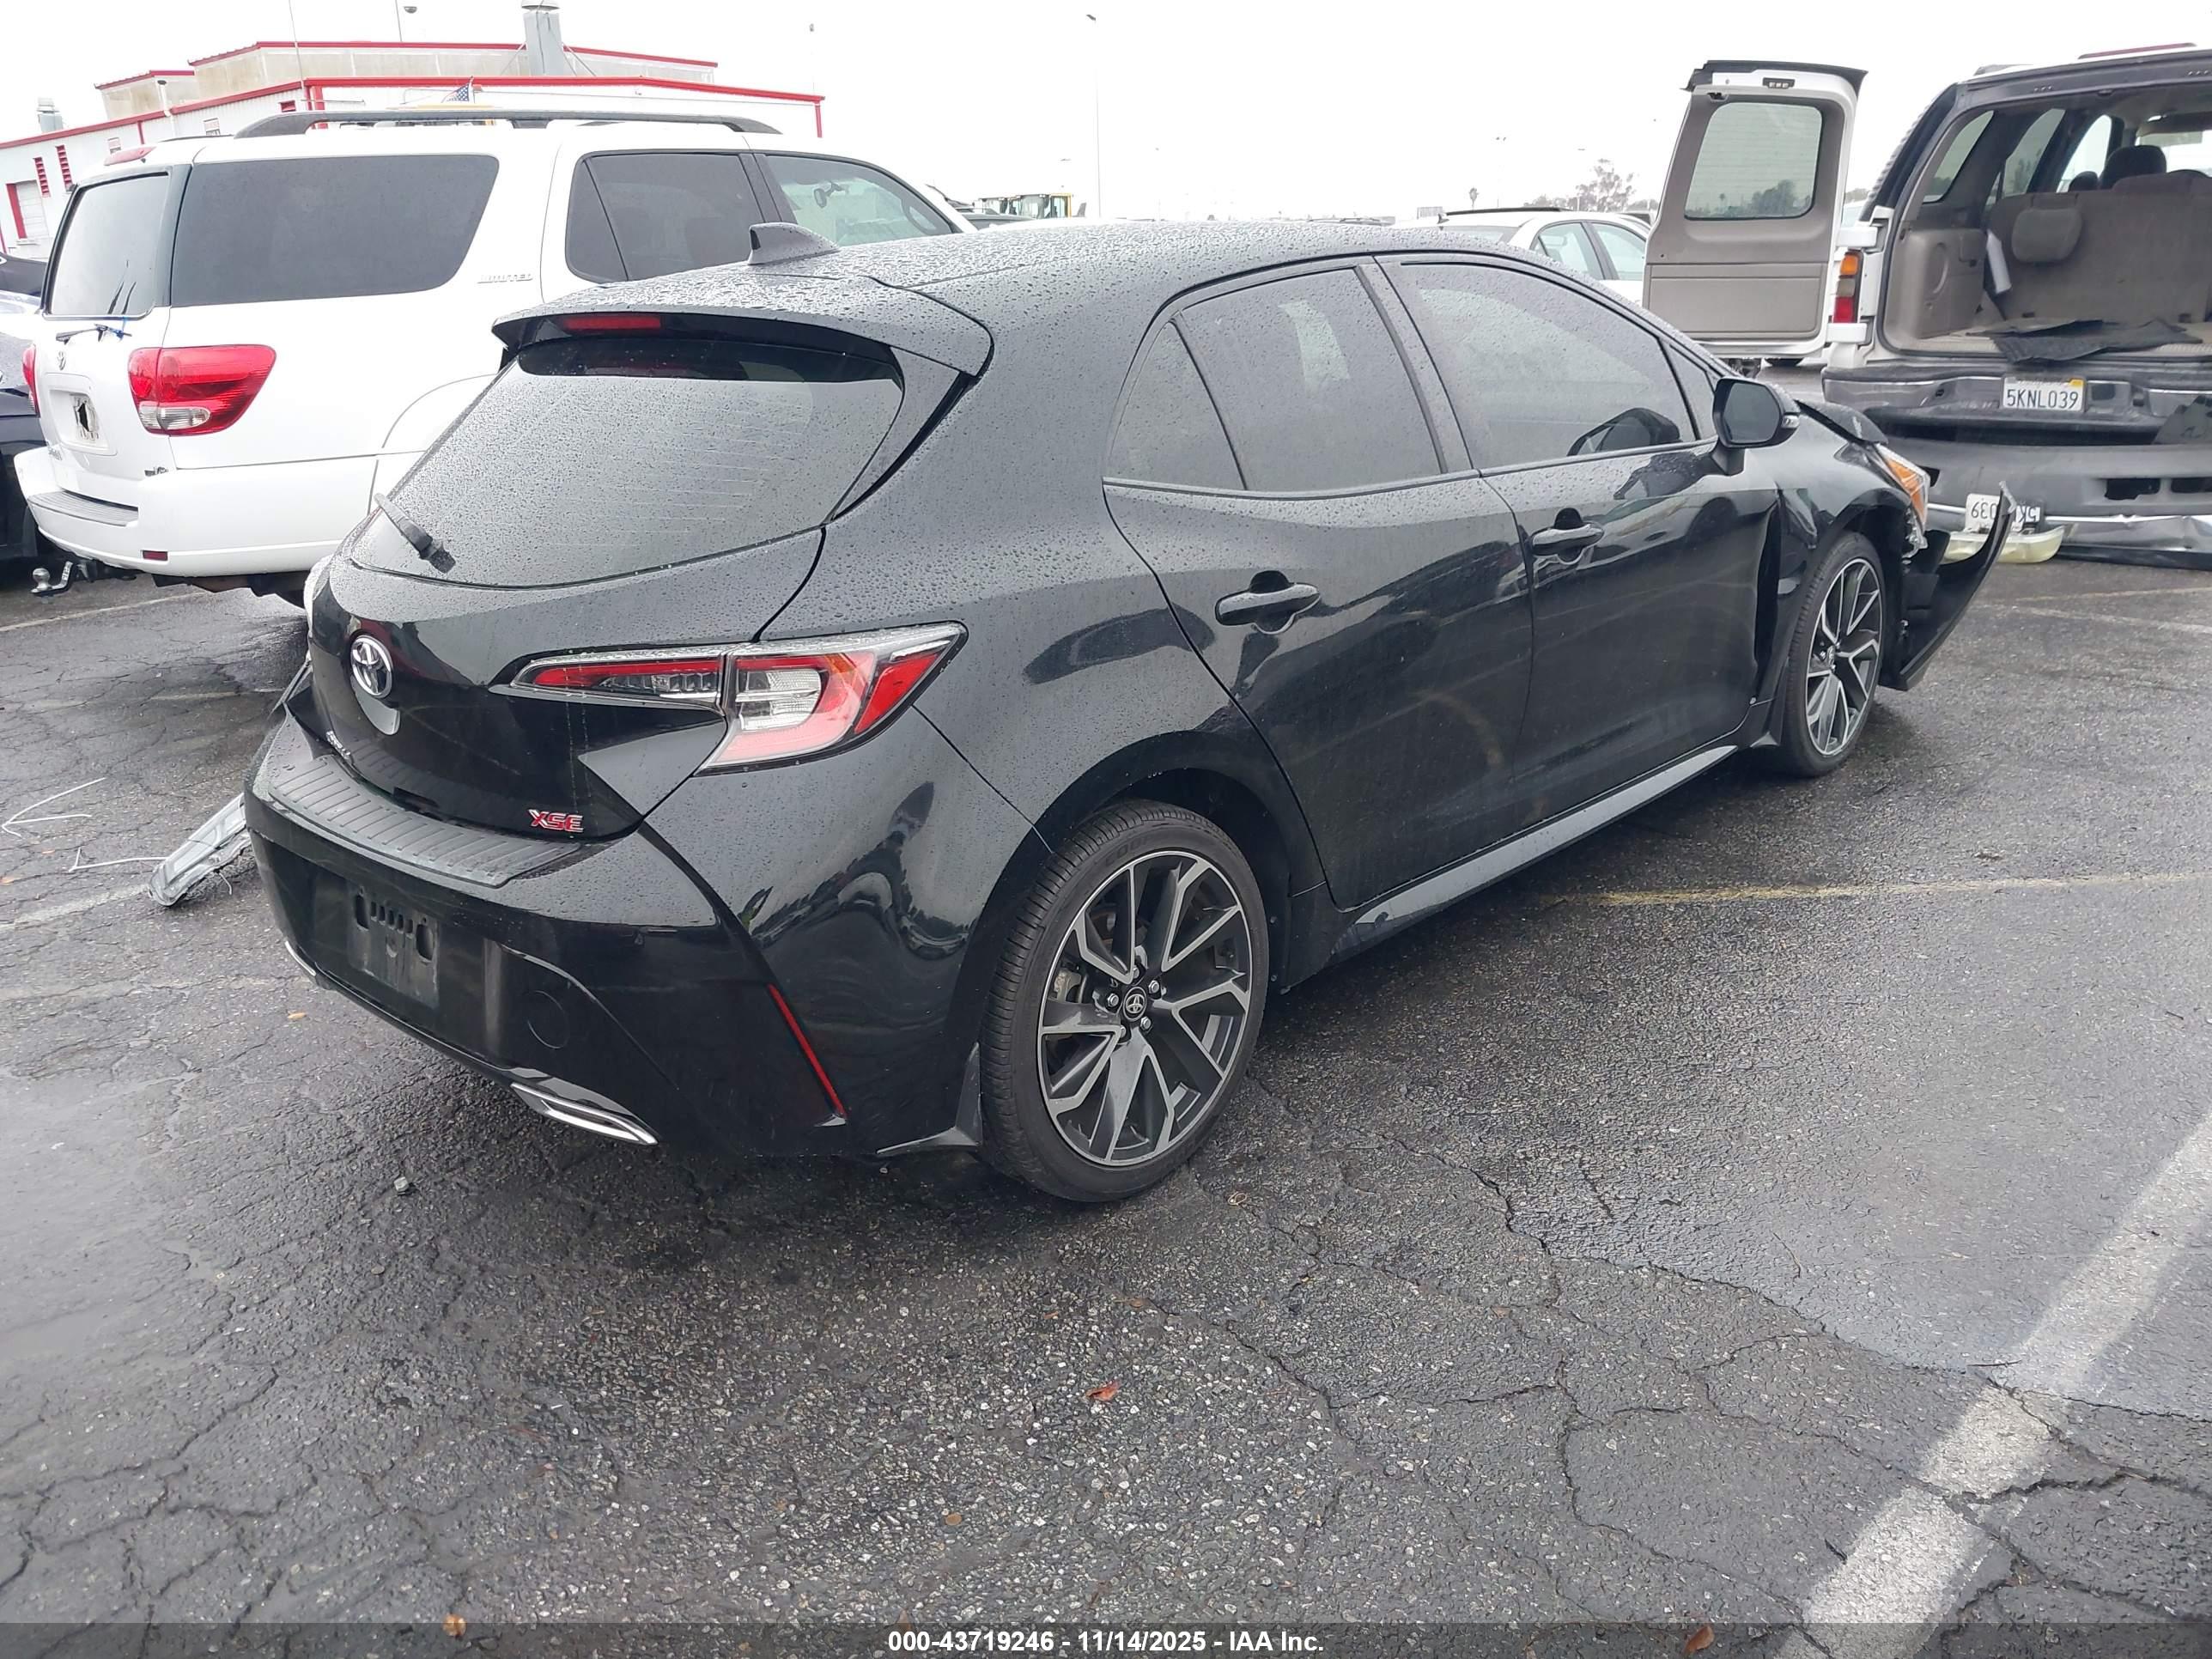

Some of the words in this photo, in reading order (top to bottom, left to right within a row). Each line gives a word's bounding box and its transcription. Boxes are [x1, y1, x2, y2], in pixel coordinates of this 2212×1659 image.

[2007, 388, 2079, 410] 5KNL039
[1971, 501, 2038, 522] 5K039
[527, 808, 584, 833] XSE
